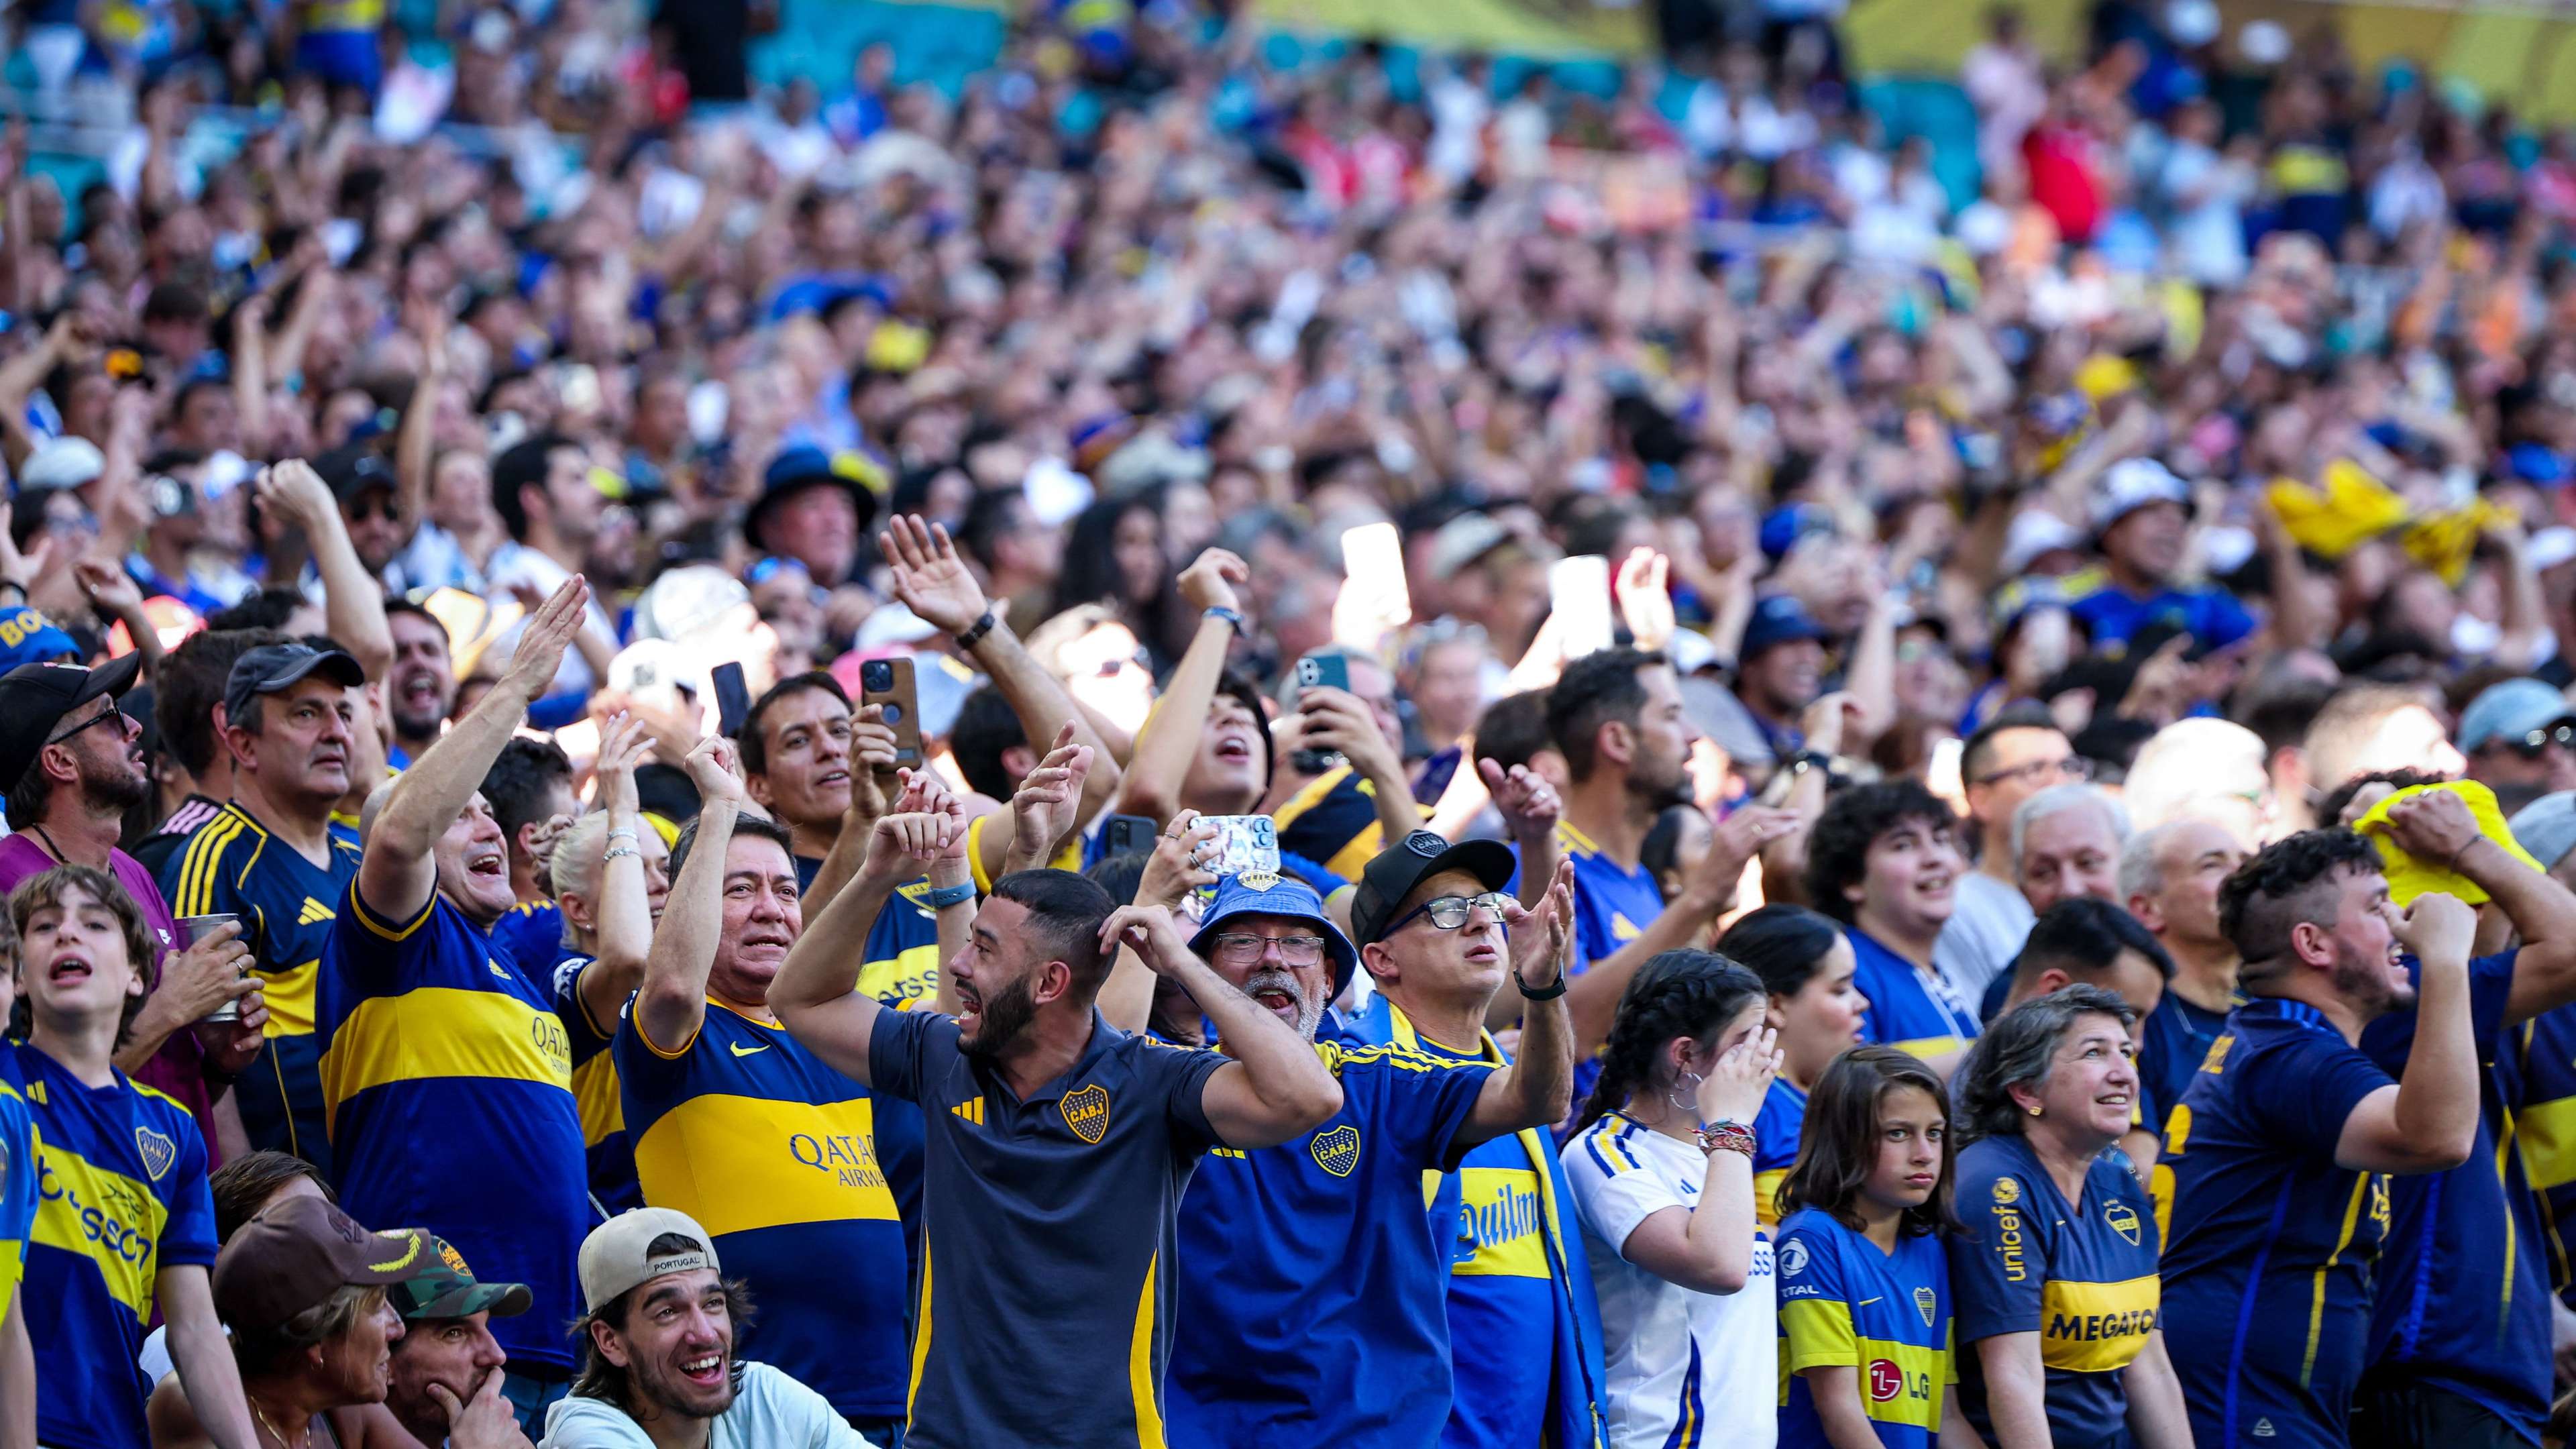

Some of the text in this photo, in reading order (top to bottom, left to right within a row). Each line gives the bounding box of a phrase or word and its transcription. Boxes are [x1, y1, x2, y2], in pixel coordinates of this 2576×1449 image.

[1070, 1102, 1104, 1123] CABJ
[1320, 1140, 1354, 1160] CABJ
[1991, 1206, 2026, 1281] unicef
[654, 1256, 700, 1272] PORTUGAL
[2047, 1308, 2157, 1341] MEGATO
[1906, 1371, 1930, 1401] LG
